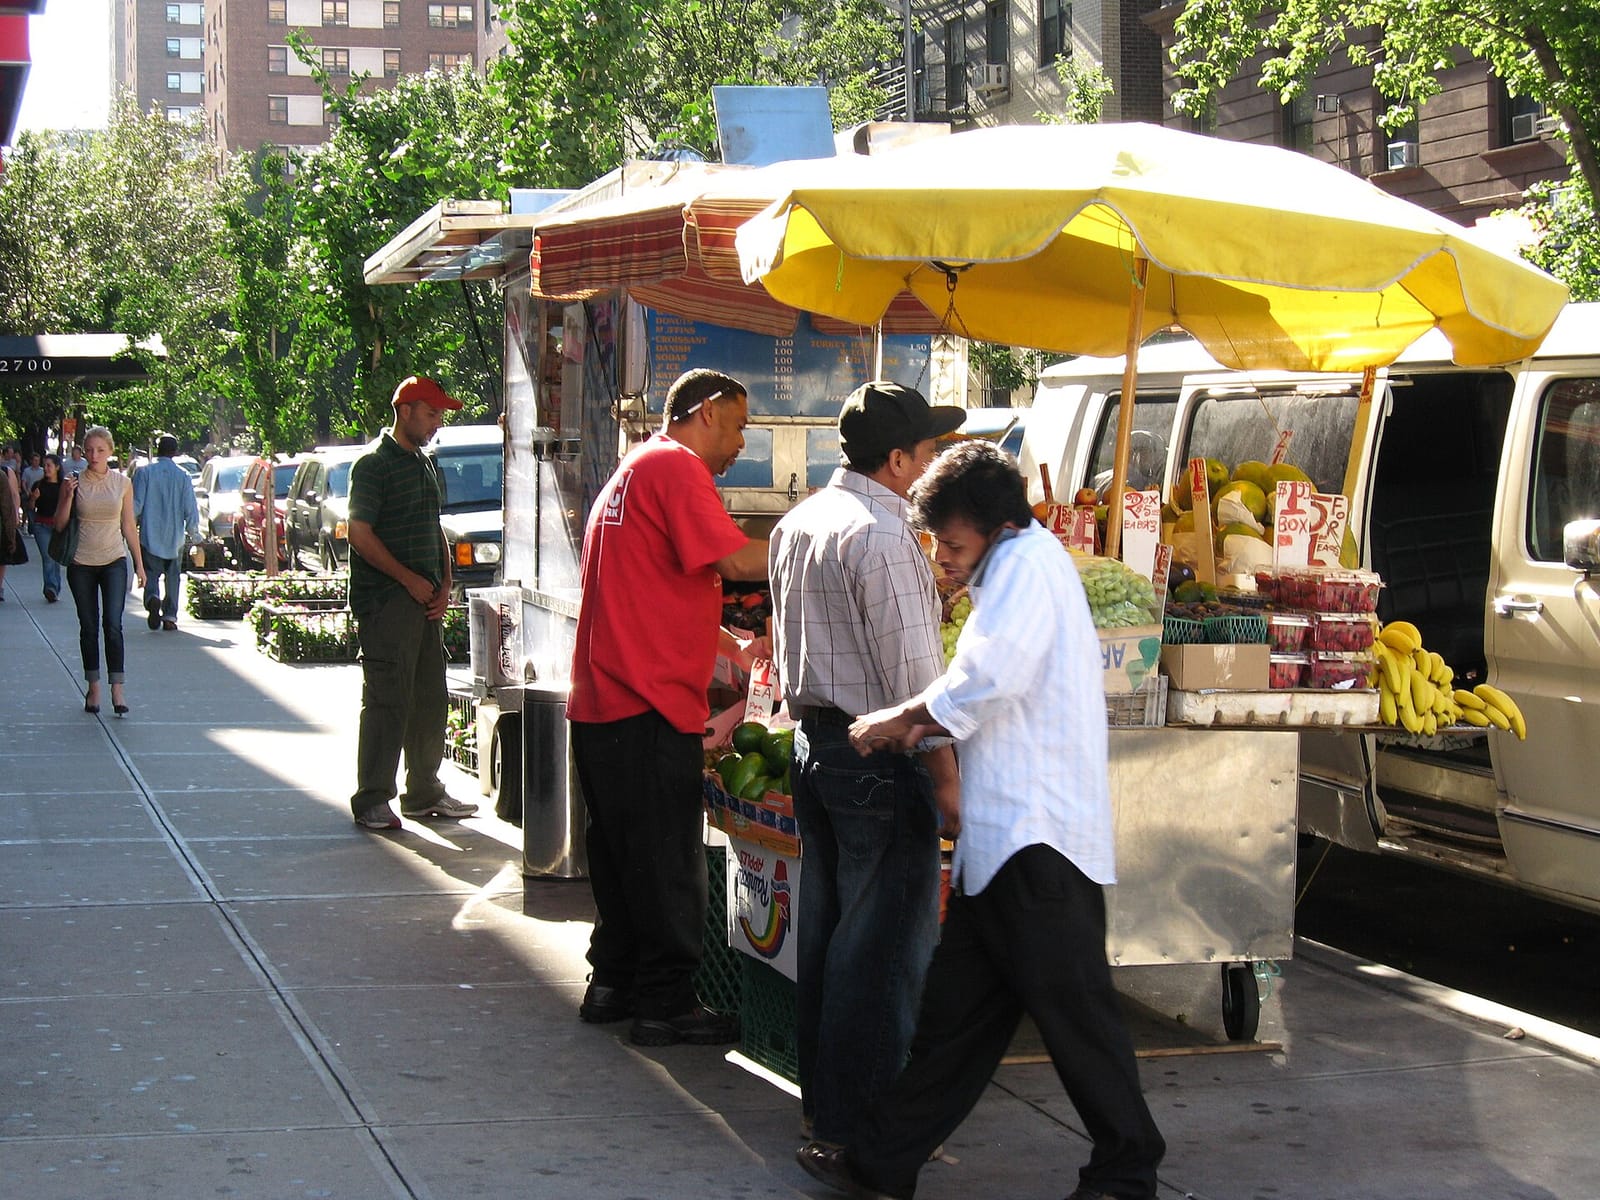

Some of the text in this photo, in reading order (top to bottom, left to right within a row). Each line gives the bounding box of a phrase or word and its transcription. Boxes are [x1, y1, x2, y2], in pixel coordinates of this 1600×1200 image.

[655, 326, 696, 334] MFFINS
[775, 339, 794, 347] 1.00
[774, 348, 793, 356] 1.00
[774, 357, 793, 365] 1.00
[0, 359, 52, 372] 2700
[774, 366, 793, 374] 1.00
[774, 384, 793, 392] 1.00
[774, 392, 793, 401] 1.00
[1277, 515, 1309, 535] BOX
[501, 647, 514, 672] POST
[752, 685, 772, 700] EA
